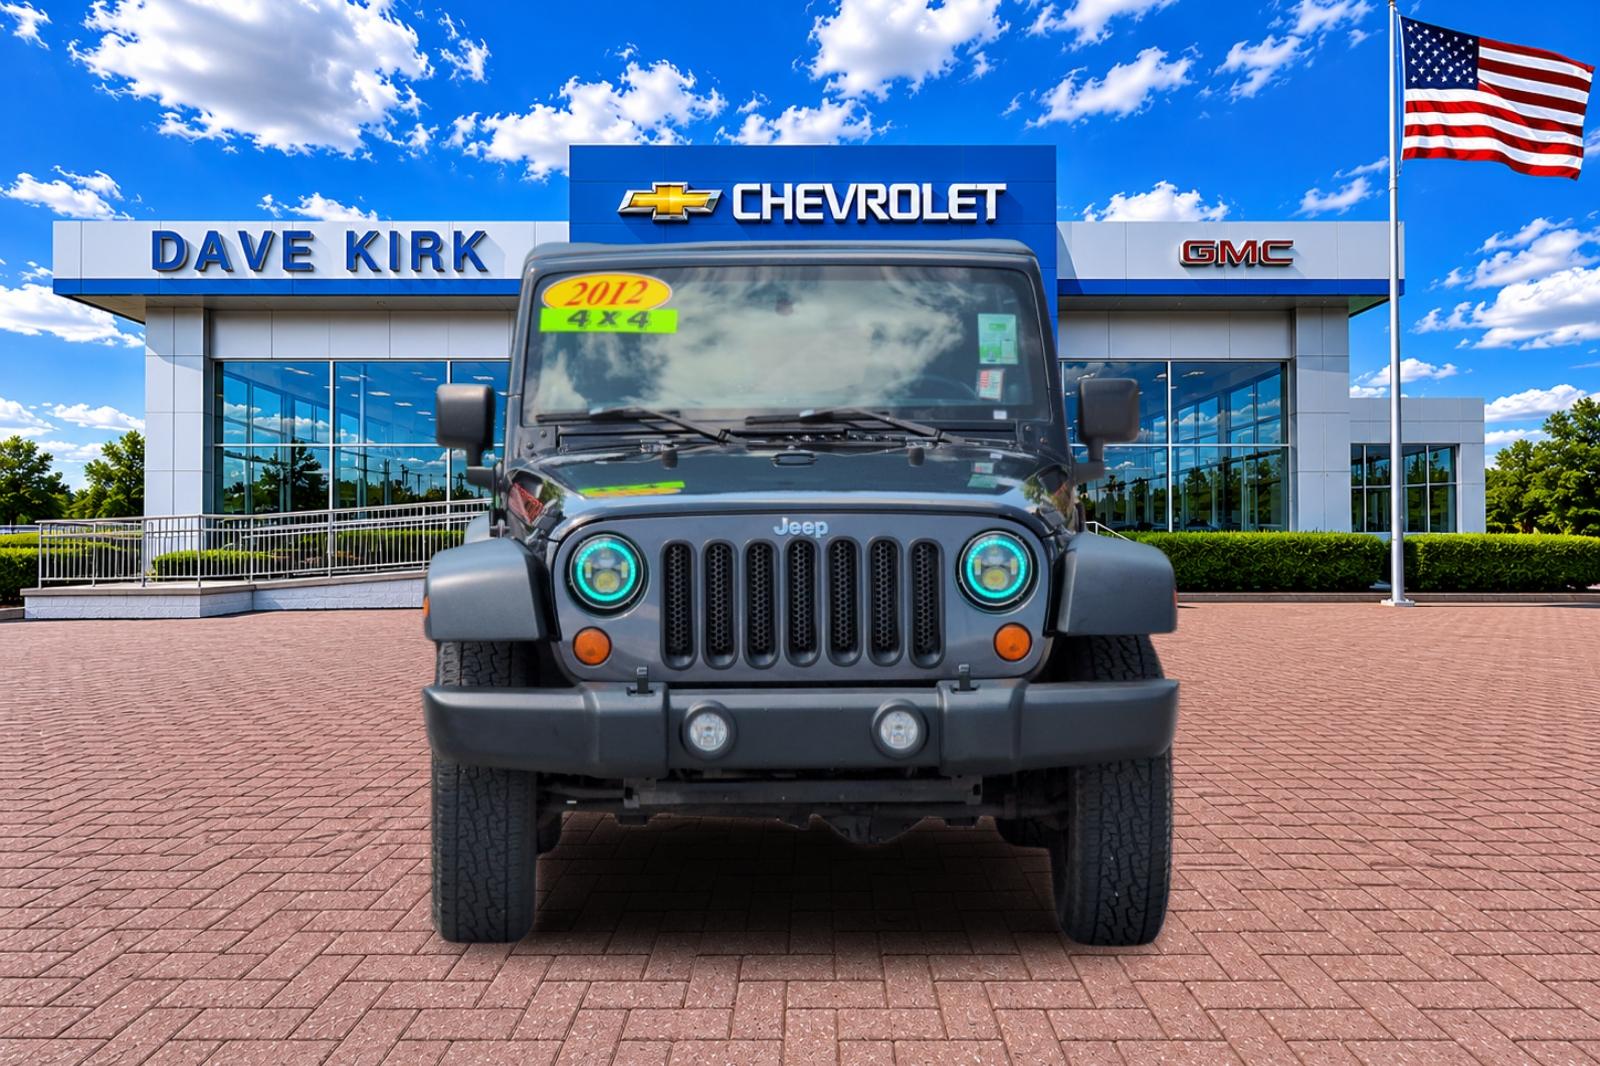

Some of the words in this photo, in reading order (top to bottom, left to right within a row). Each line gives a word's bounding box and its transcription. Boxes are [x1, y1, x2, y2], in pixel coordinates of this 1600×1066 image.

[732, 183, 1007, 221] CHEVROLET
[151, 230, 315, 272] DAVE
[346, 230, 488, 272] KIRK
[1181, 239, 1295, 267] GMC
[563, 280, 649, 306] 2012
[773, 516, 829, 538] Jeep
